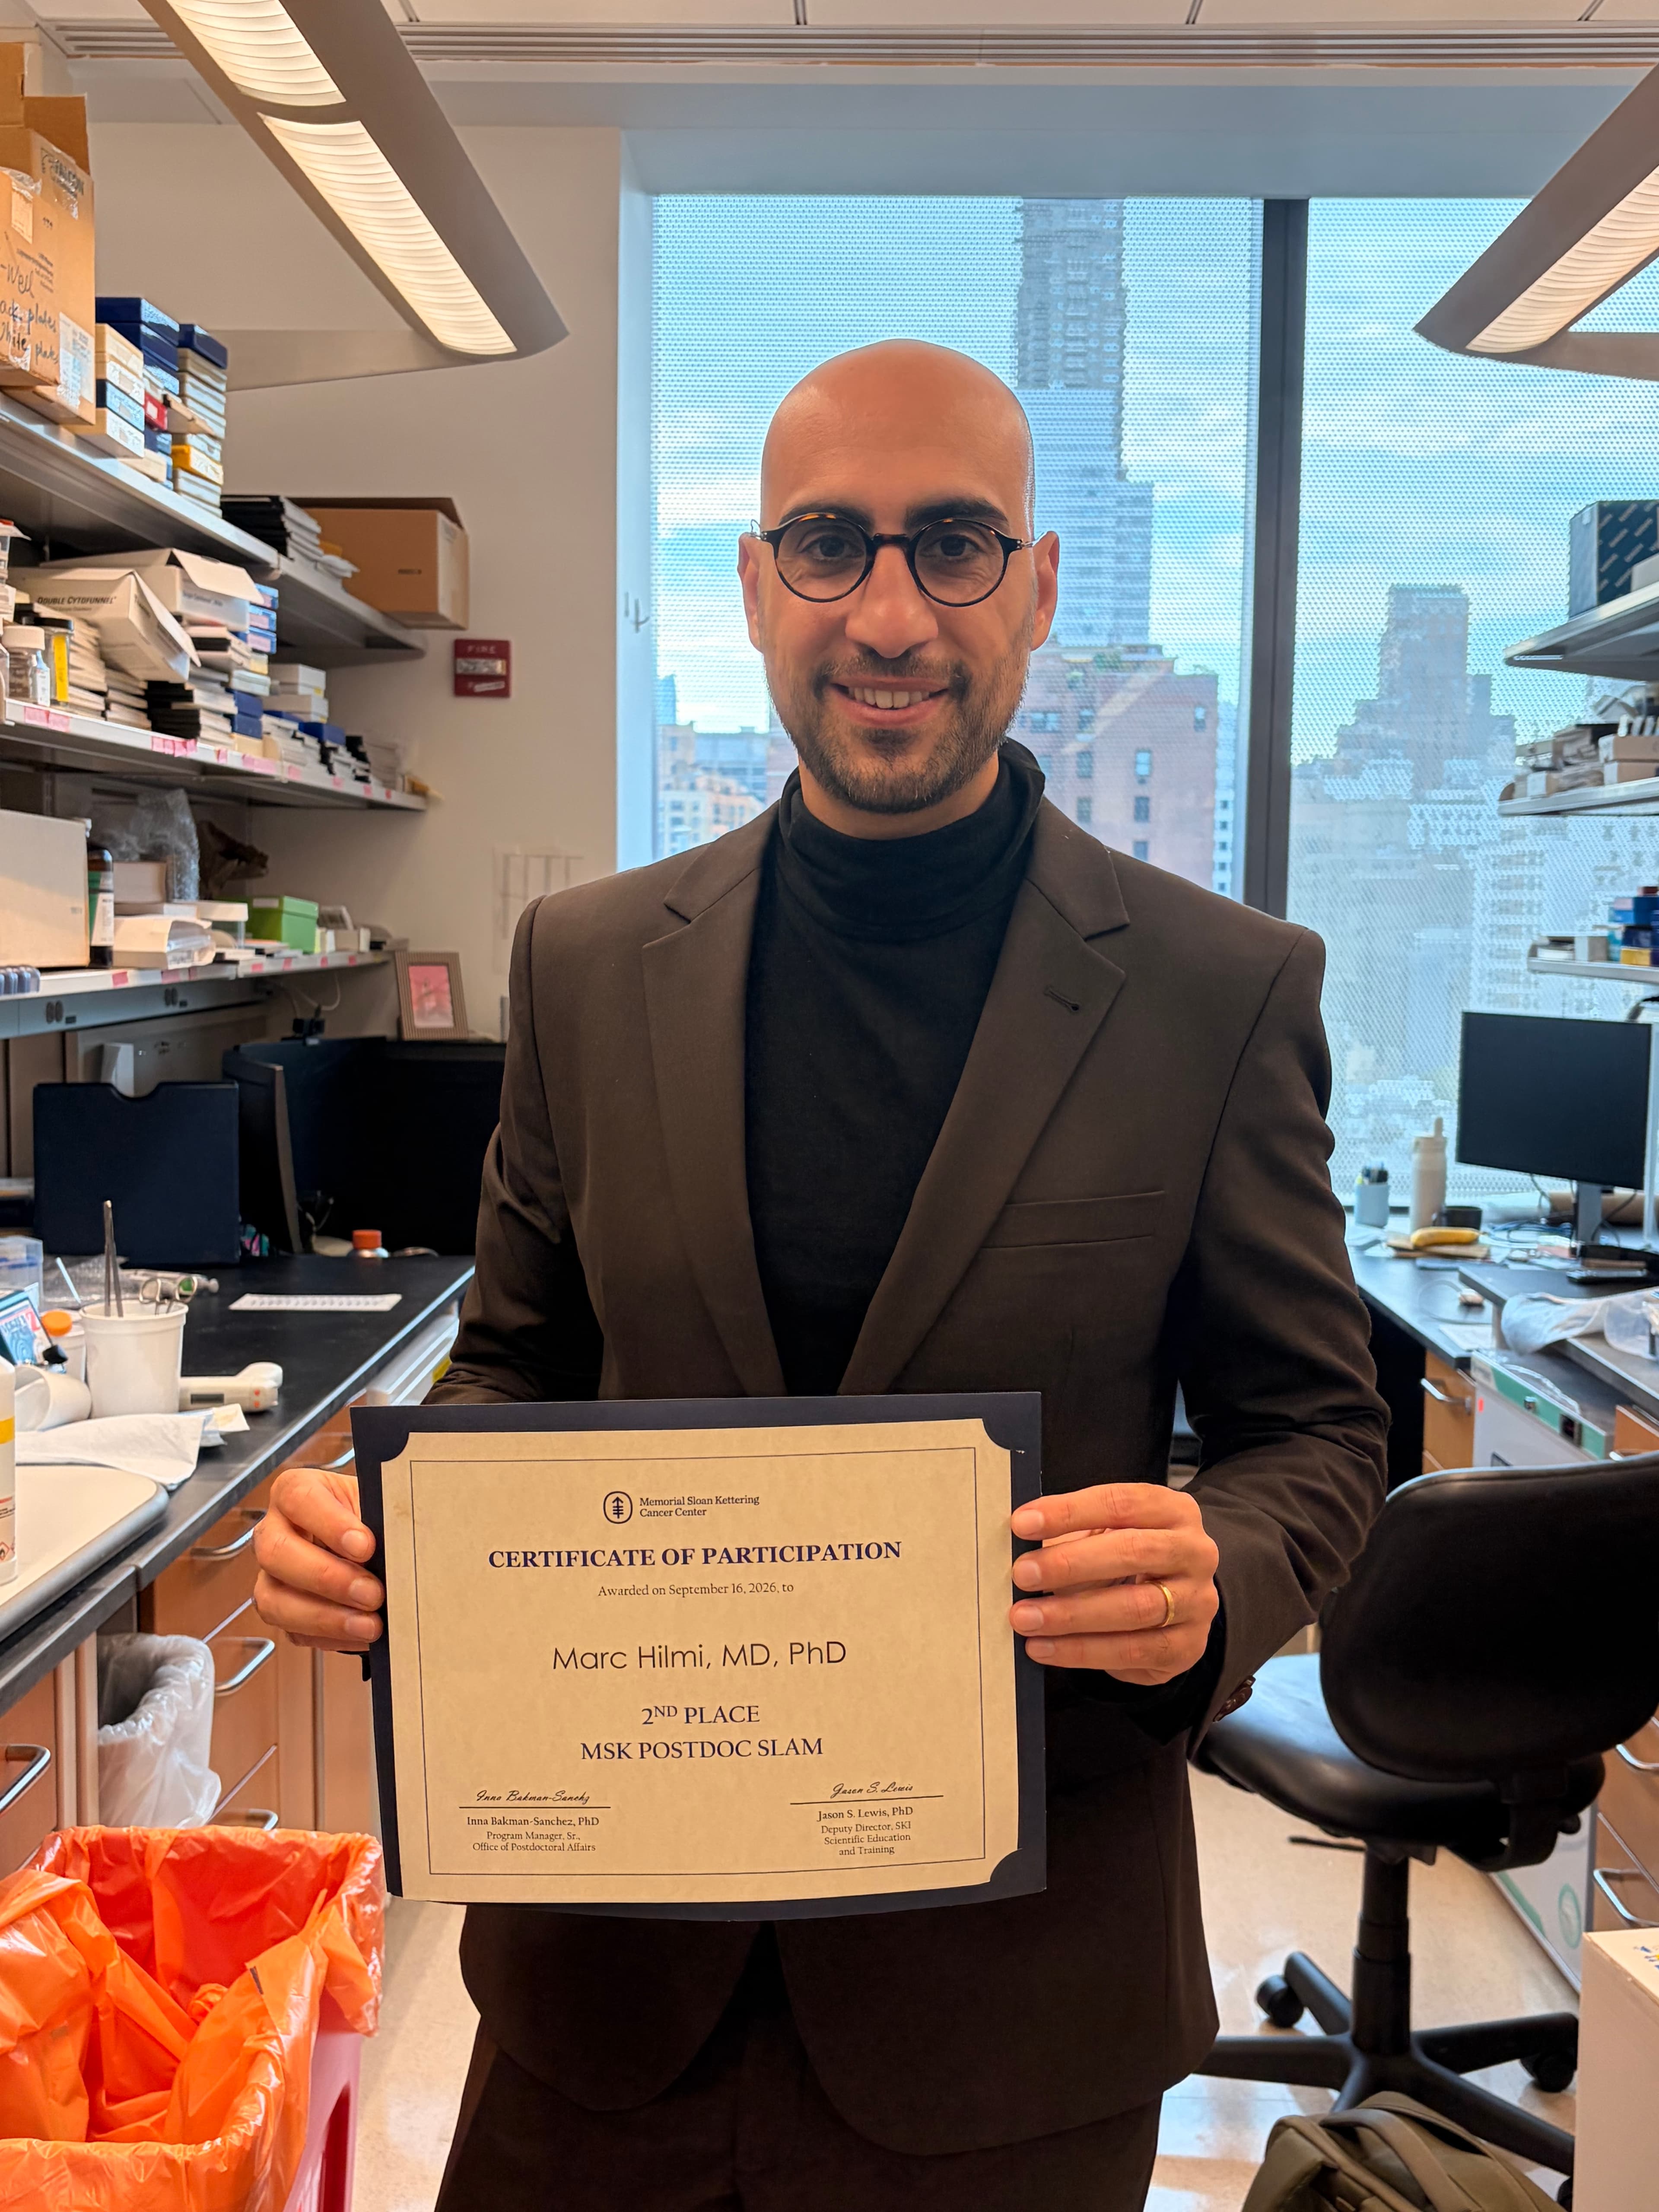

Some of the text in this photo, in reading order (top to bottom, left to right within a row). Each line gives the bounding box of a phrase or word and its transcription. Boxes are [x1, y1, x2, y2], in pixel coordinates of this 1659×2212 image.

[639, 1495, 760, 1506] Memorial Sloan Kettering
[639, 1507, 707, 1517] Cancer Center
[489, 1541, 902, 1568] CERTIFICATE OF PARTICIPATION
[597, 1584, 649, 1596] Awarded
[669, 1583, 729, 1598] September
[731, 1583, 746, 1594] 16,
[748, 1582, 779, 1593] 2026,
[782, 1584, 794, 1592] to
[553, 1641, 846, 1670] Marc Hilmi, MD, PhD
[641, 1705, 760, 1725] 2ND PLACE
[580, 1738, 823, 1760] MSK POSTDOC SLAM
[866, 1781, 880, 1793] S.
[816, 1806, 913, 1822] Jason S. Lewis, PhD
[467, 1816, 599, 1827] Inna Bakman-Sanchez, PhD
[821, 1821, 911, 1836] Deputy Director, SKI
[486, 1831, 523, 1842] Program
[525, 1831, 565, 1842] Manager,
[824, 1833, 911, 1845] Scientific Education
[473, 1842, 596, 1851] Office of Postdoctoral Affairs
[839, 1845, 895, 1856] and Training
